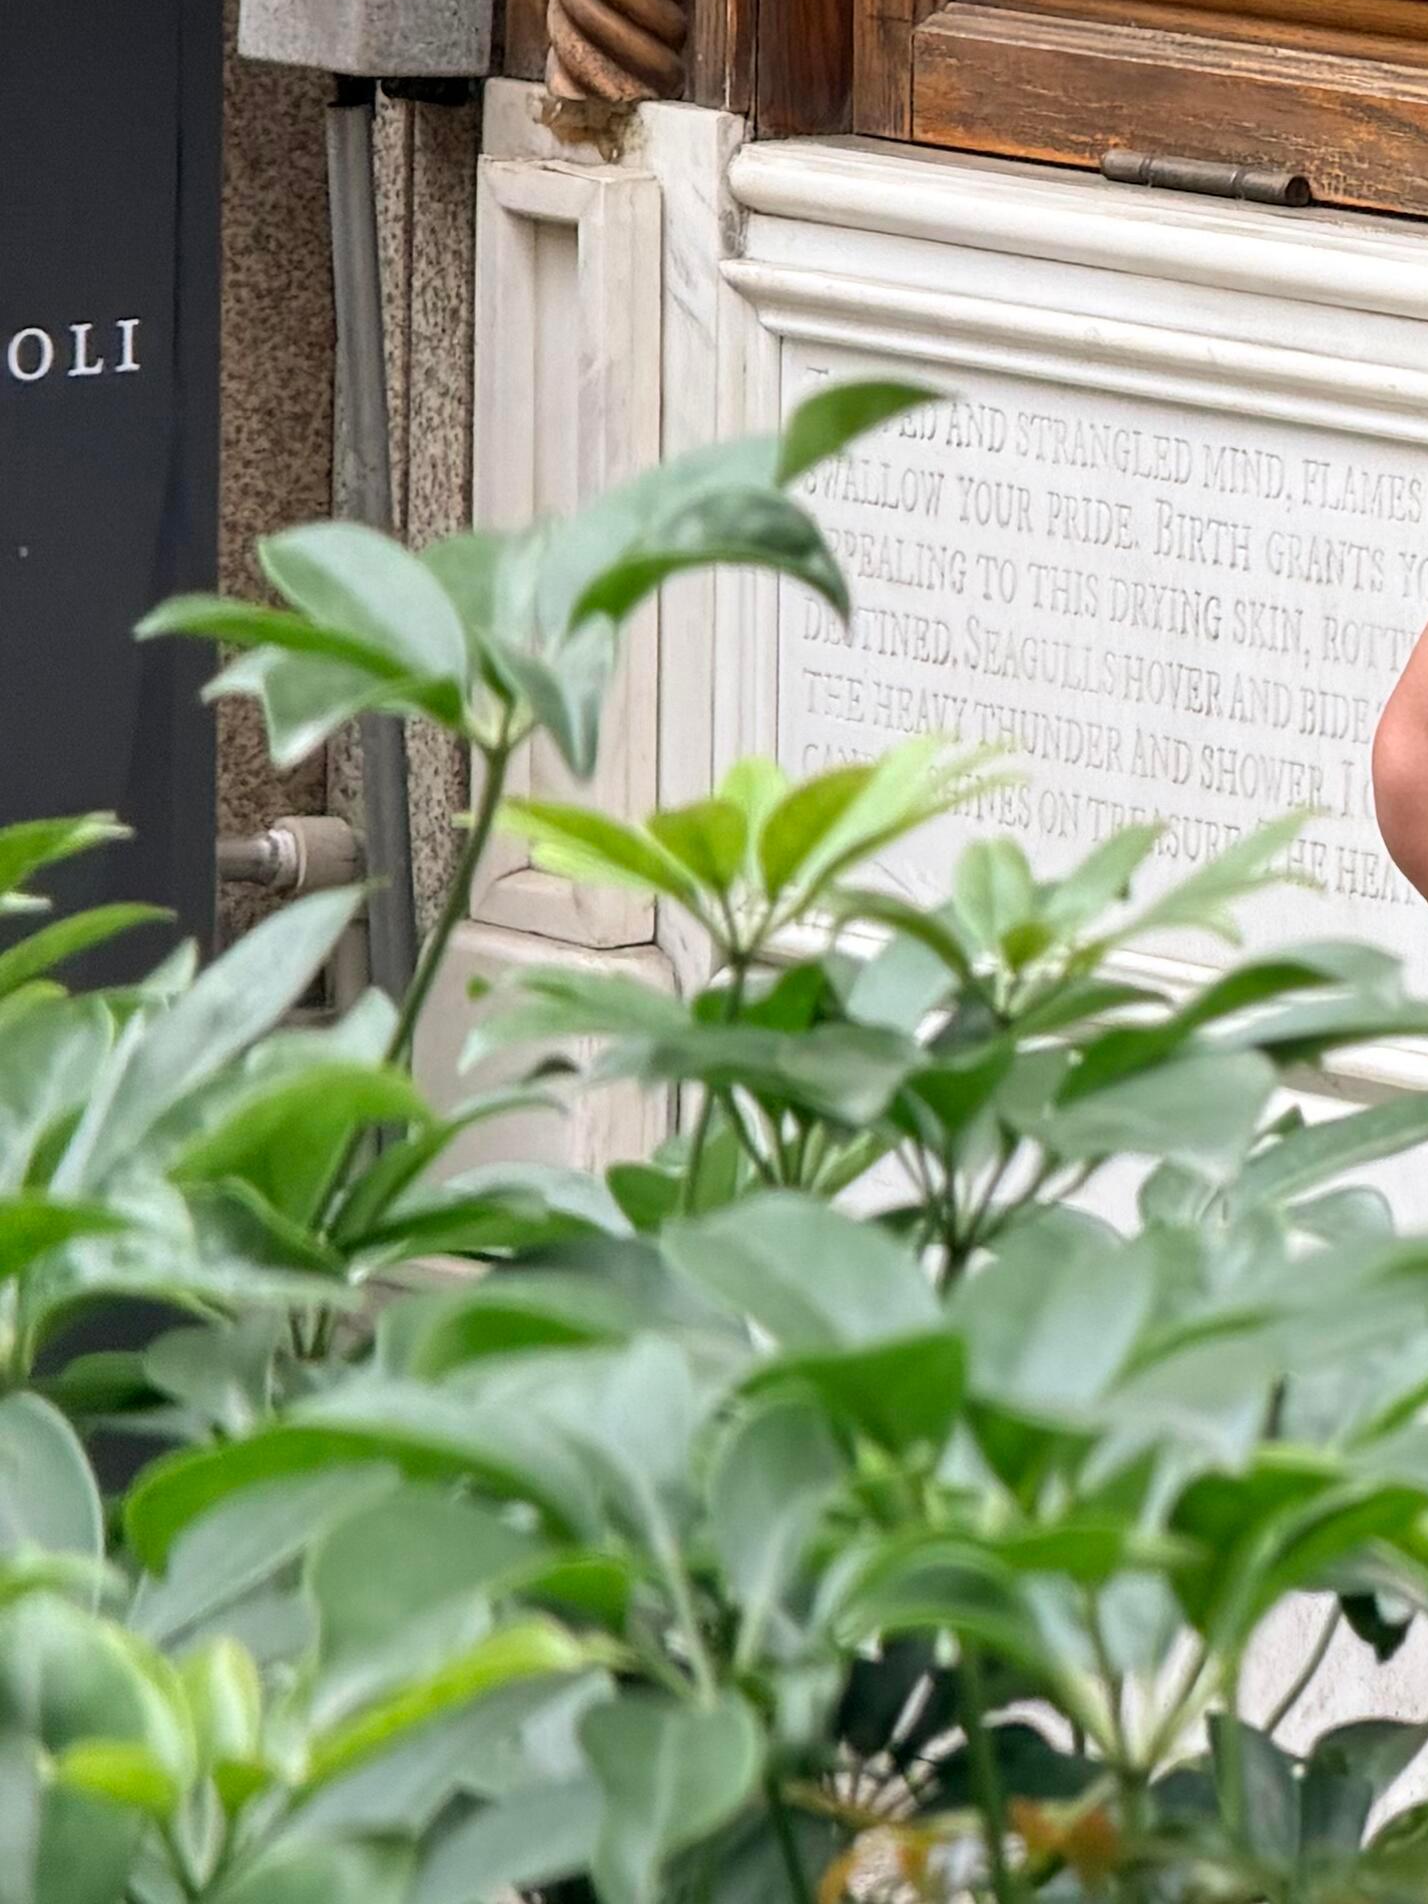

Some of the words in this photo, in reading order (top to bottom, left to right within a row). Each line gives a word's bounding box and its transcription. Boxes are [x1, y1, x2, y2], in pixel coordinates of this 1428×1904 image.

[7, 318, 141, 381] OLI
[945, 401, 1008, 453] AND
[1015, 411, 1193, 485] STRANGLED
[1301, 457, 1422, 524] FLAMES
[956, 474, 1033, 533] YOUR
[1046, 490, 1140, 550] PRIDE.
[1153, 496, 1252, 573] BIRTH
[1265, 530, 1385, 593] GRANTS
[964, 613, 1116, 696] SEAGULLS
[1122, 652, 1224, 719] HOVER
[1228, 672, 1292, 730] AND
[975, 553, 1018, 604] TO
[1027, 561, 1099, 619] THIS
[1108, 577, 1223, 642] DRYING
[1321, 614, 1418, 673] ROTT
[802, 666, 865, 723] THE
[872, 679, 968, 743] HEAVY
[973, 699, 1123, 774] THUNDER
[1130, 721, 1194, 785] AND
[1037, 789, 1081, 838] ON
